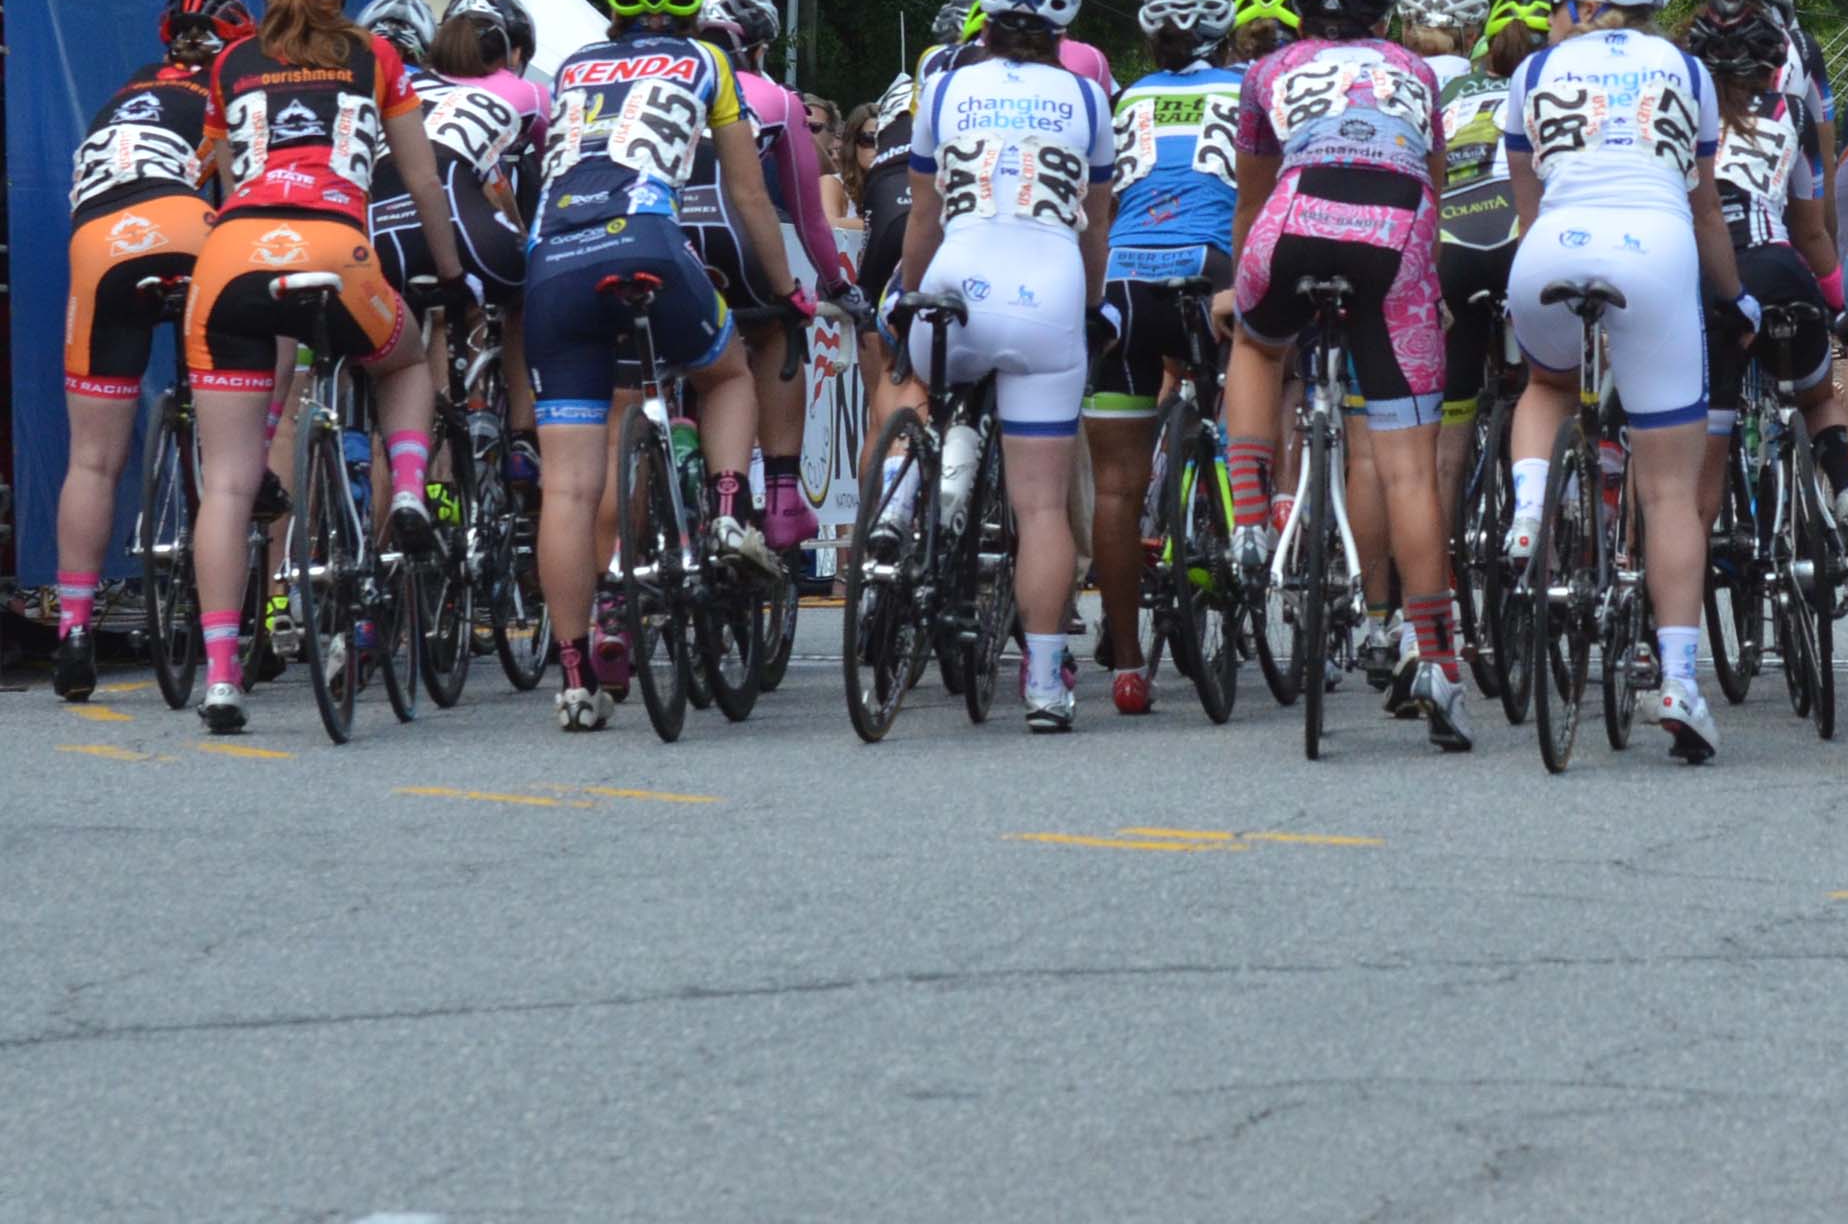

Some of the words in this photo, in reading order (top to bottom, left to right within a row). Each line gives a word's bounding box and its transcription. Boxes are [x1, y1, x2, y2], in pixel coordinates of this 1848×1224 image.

[561, 54, 700, 86] KENDA
[436, 92, 511, 164] 218
[626, 86, 697, 179] 245
[957, 96, 1073, 120] changing
[957, 112, 1063, 132] diabetes
[1533, 88, 1588, 161] 287
[1654, 88, 1698, 175] 287
[1033, 146, 1082, 227] 248
[1440, 194, 1508, 219] COLAVITA
